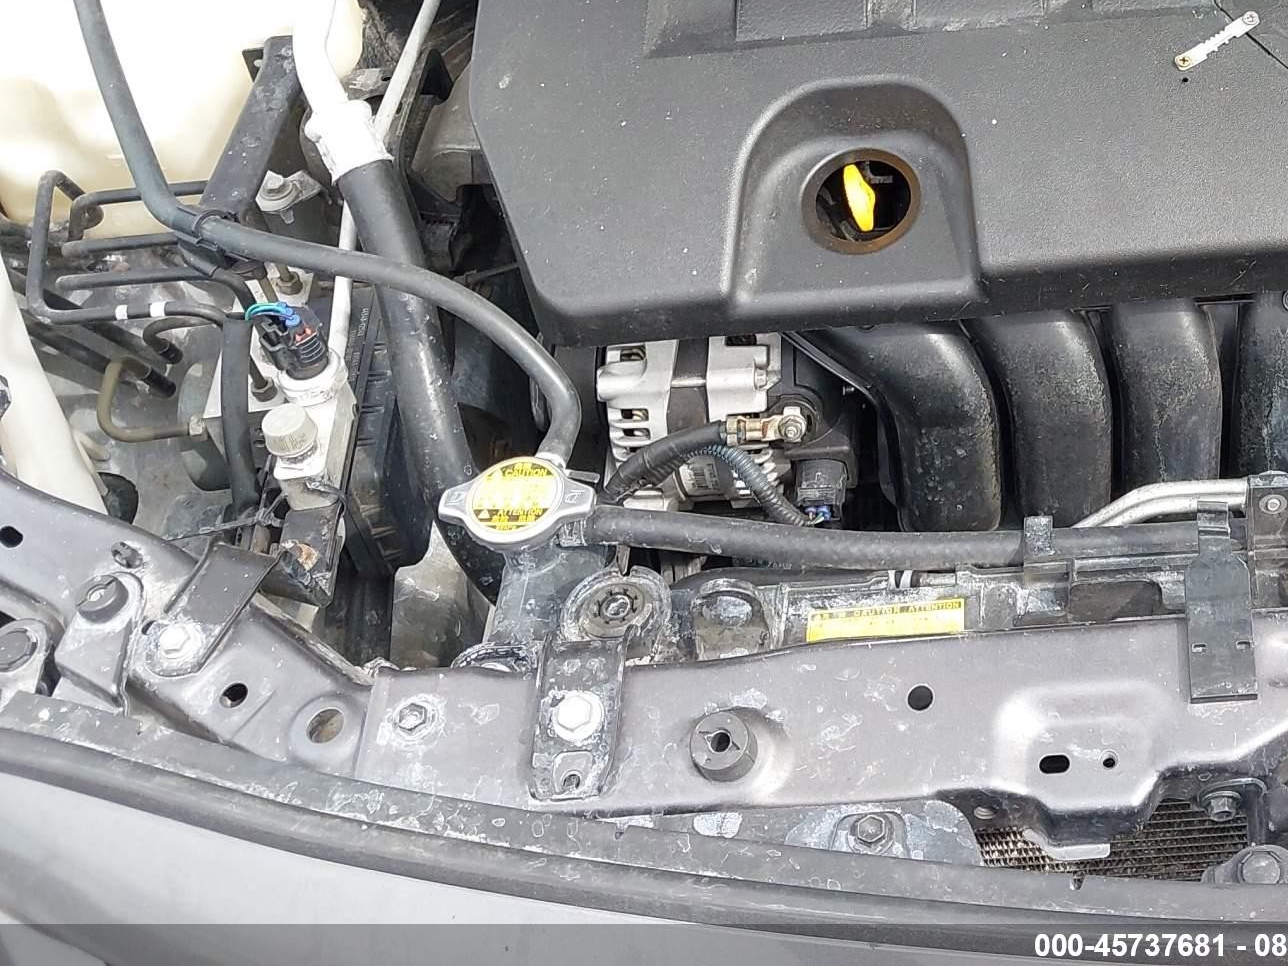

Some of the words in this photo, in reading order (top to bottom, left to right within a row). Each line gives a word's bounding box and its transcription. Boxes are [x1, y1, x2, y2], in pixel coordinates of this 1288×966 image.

[505, 468, 547, 477] CAUTION
[497, 507, 543, 516] ATTENTION
[854, 607, 900, 617] CAUTION
[908, 601, 960, 612] ATTENTION
